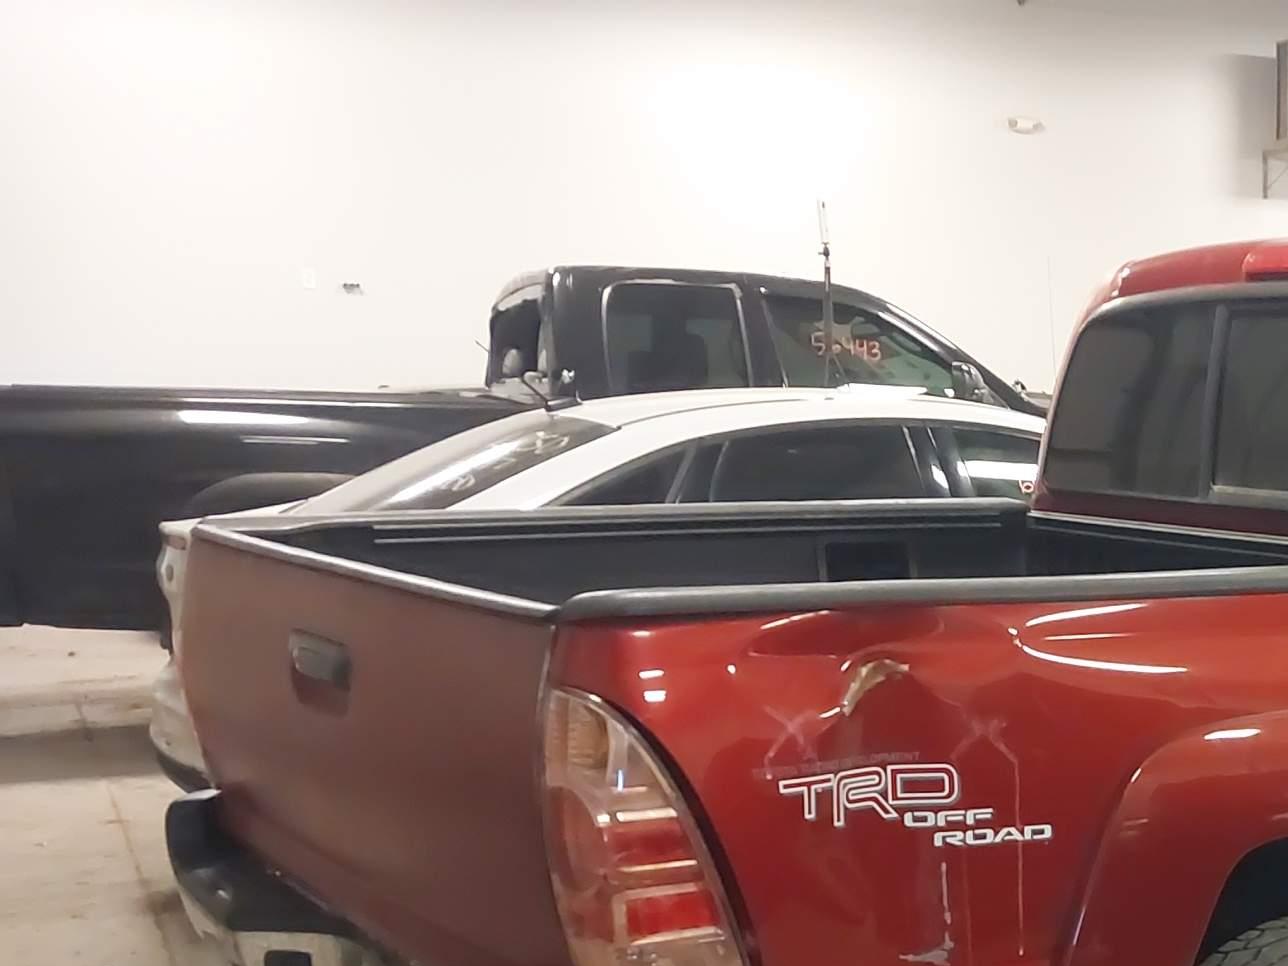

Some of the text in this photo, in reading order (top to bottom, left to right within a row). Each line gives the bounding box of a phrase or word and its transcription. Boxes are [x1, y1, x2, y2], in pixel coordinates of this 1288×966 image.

[778, 762, 960, 828] TRD
[903, 807, 994, 828] OFF
[933, 824, 1053, 847] ROAD
